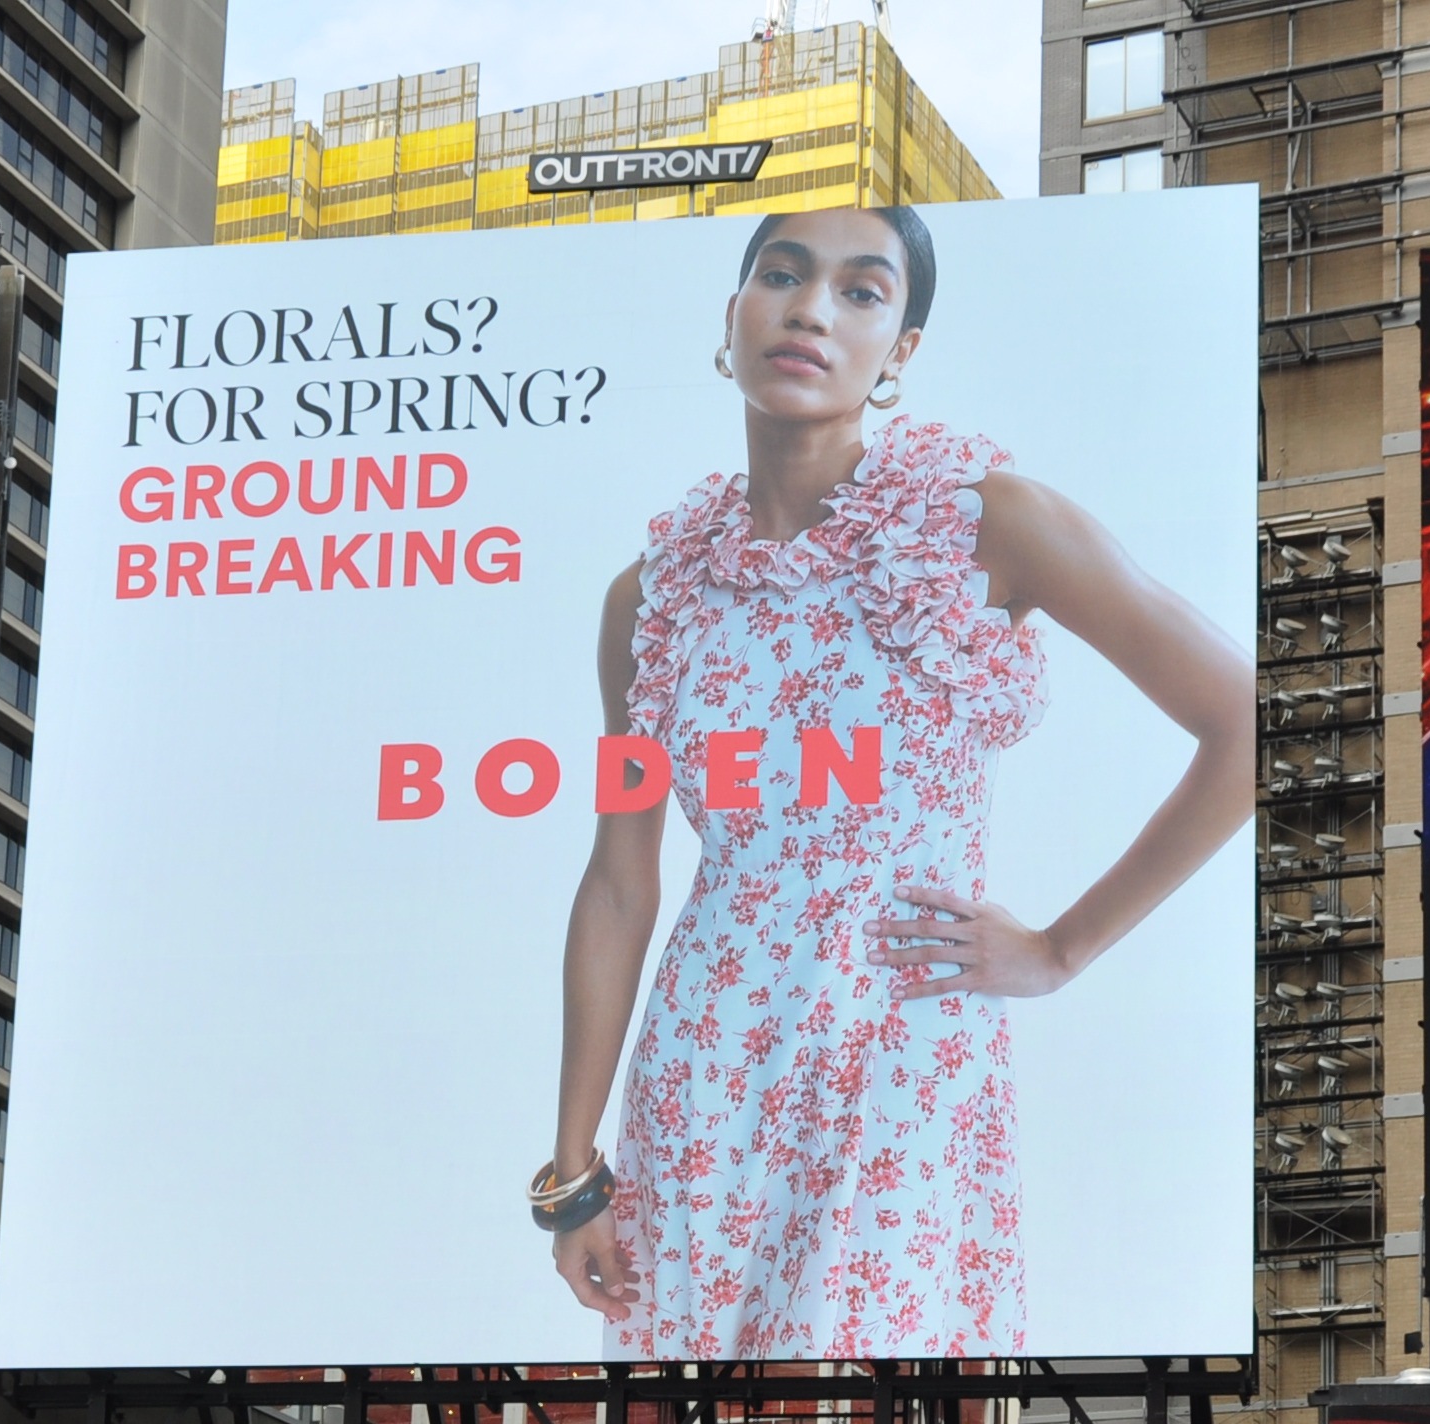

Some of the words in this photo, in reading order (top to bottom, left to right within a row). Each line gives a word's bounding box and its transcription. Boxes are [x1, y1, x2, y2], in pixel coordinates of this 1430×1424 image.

[126, 296, 499, 372] FLORALS?
[121, 385, 268, 447] FOR
[293, 366, 607, 439] SPRING?
[119, 453, 468, 523] GROUND
[115, 526, 522, 600] BREAKING
[377, 726, 882, 821] BODEN
